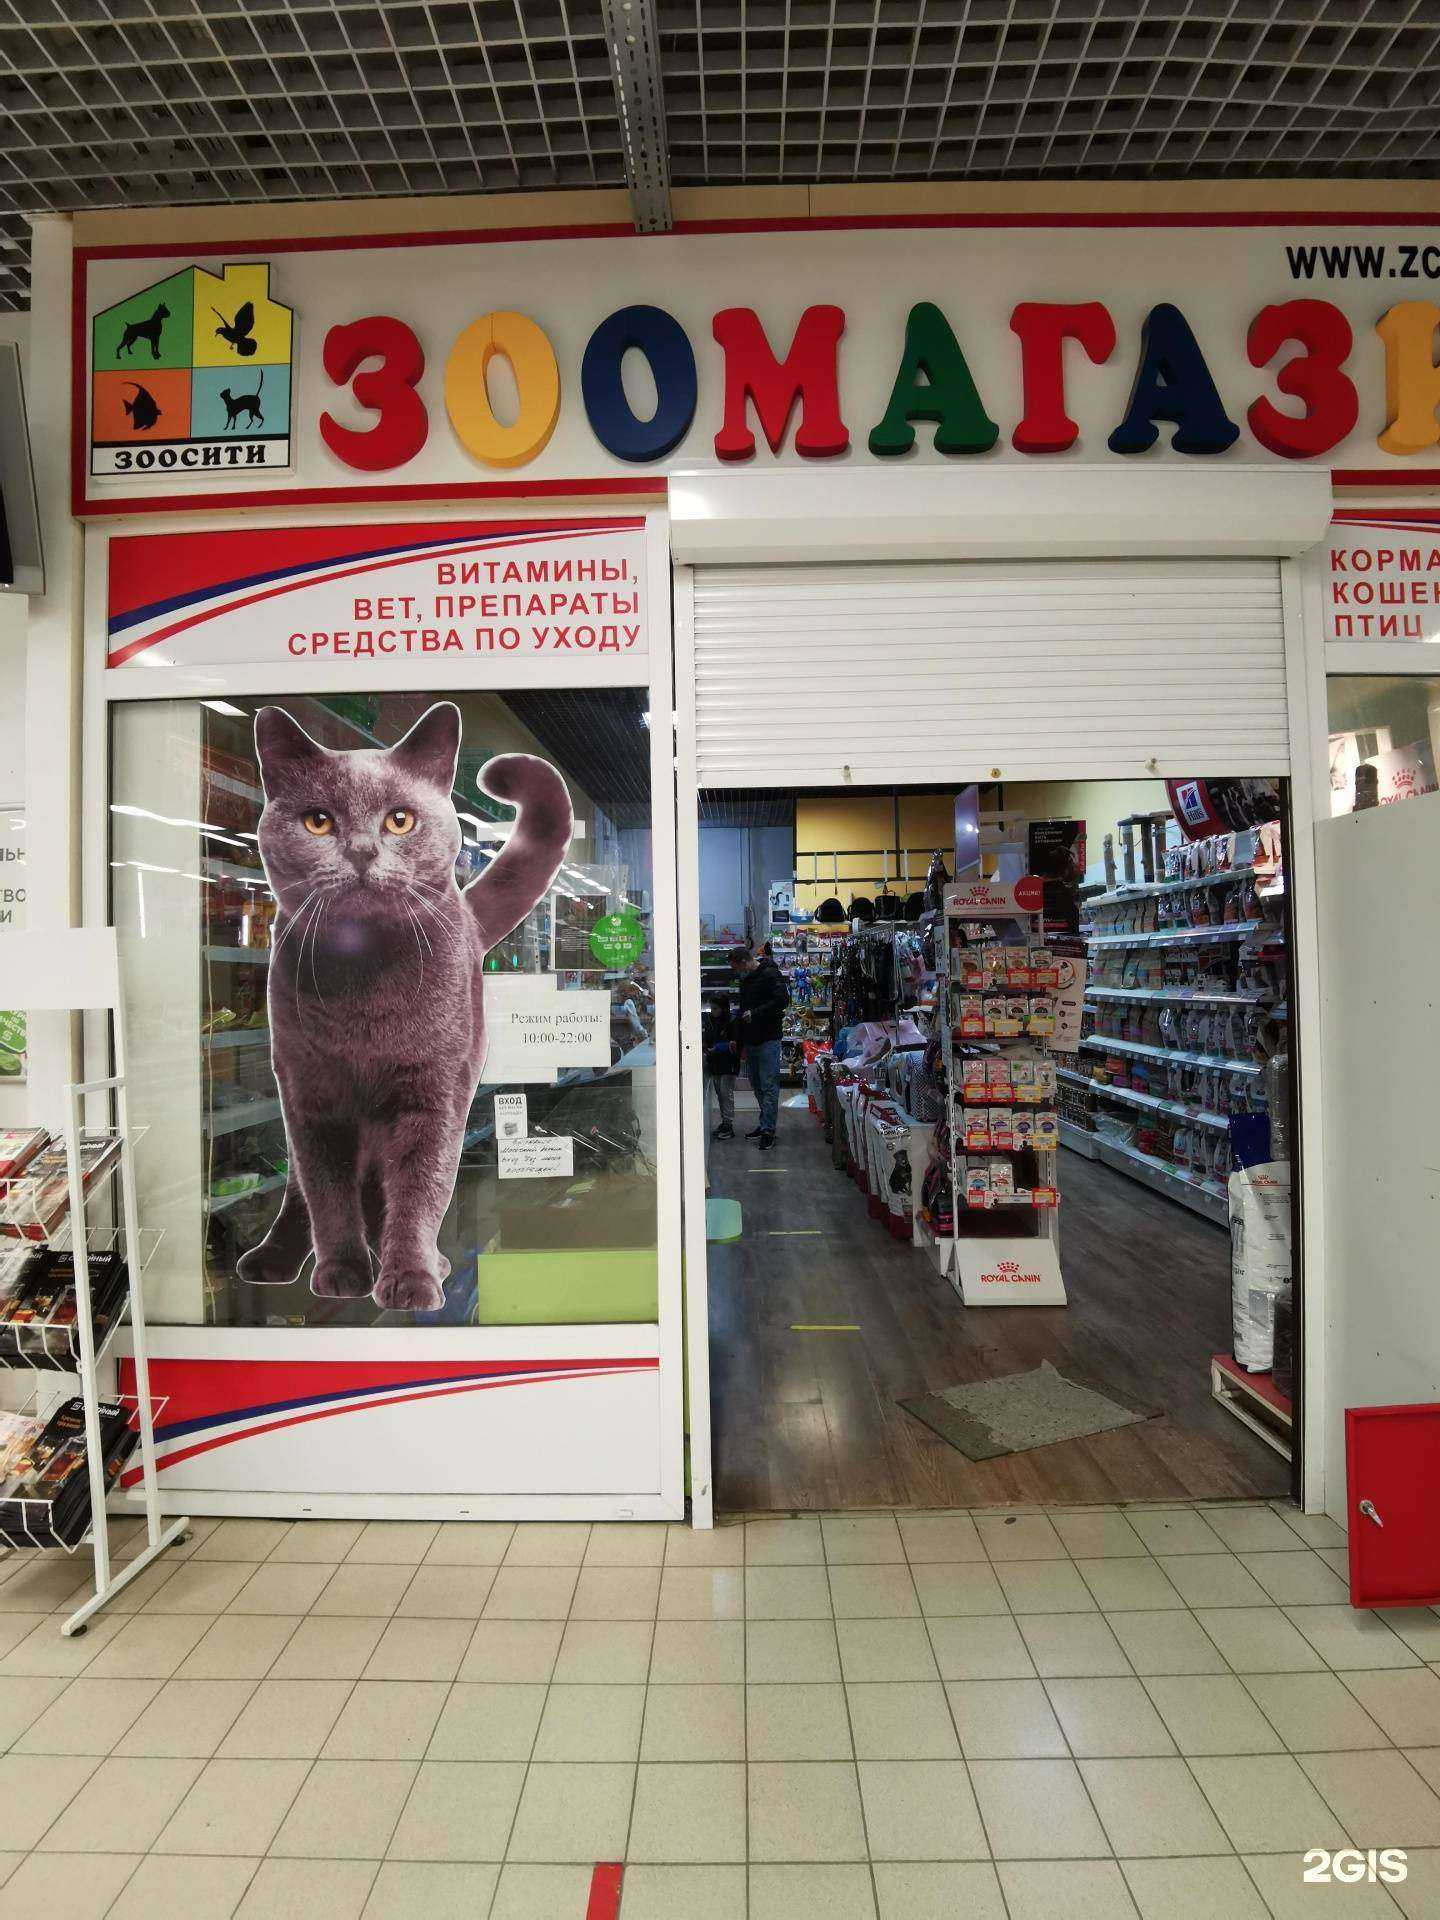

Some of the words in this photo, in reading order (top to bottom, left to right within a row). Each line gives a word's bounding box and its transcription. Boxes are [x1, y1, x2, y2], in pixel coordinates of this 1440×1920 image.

[114, 444, 266, 470] ЗООСИТИ
[437, 558, 638, 586] ВИТАМИНЫ,
[1330, 548, 1440, 572] КОРМА
[354, 596, 422, 623] ВЕТ,
[435, 592, 639, 618] ПРЕПАРАТЫ
[1335, 614, 1423, 639] ПТИЦ
[288, 628, 464, 658] СРЕДСТВА
[475, 627, 521, 651] ПО
[531, 624, 641, 652] УХОДУ
[511, 1012, 552, 1024] Режим
[522, 1032, 593, 1044] 10:00-22:00
[498, 1096, 523, 1105] ВХОД
[981, 1274, 1010, 1283] ROYAL
[1011, 1274, 1041, 1283] CANIN
